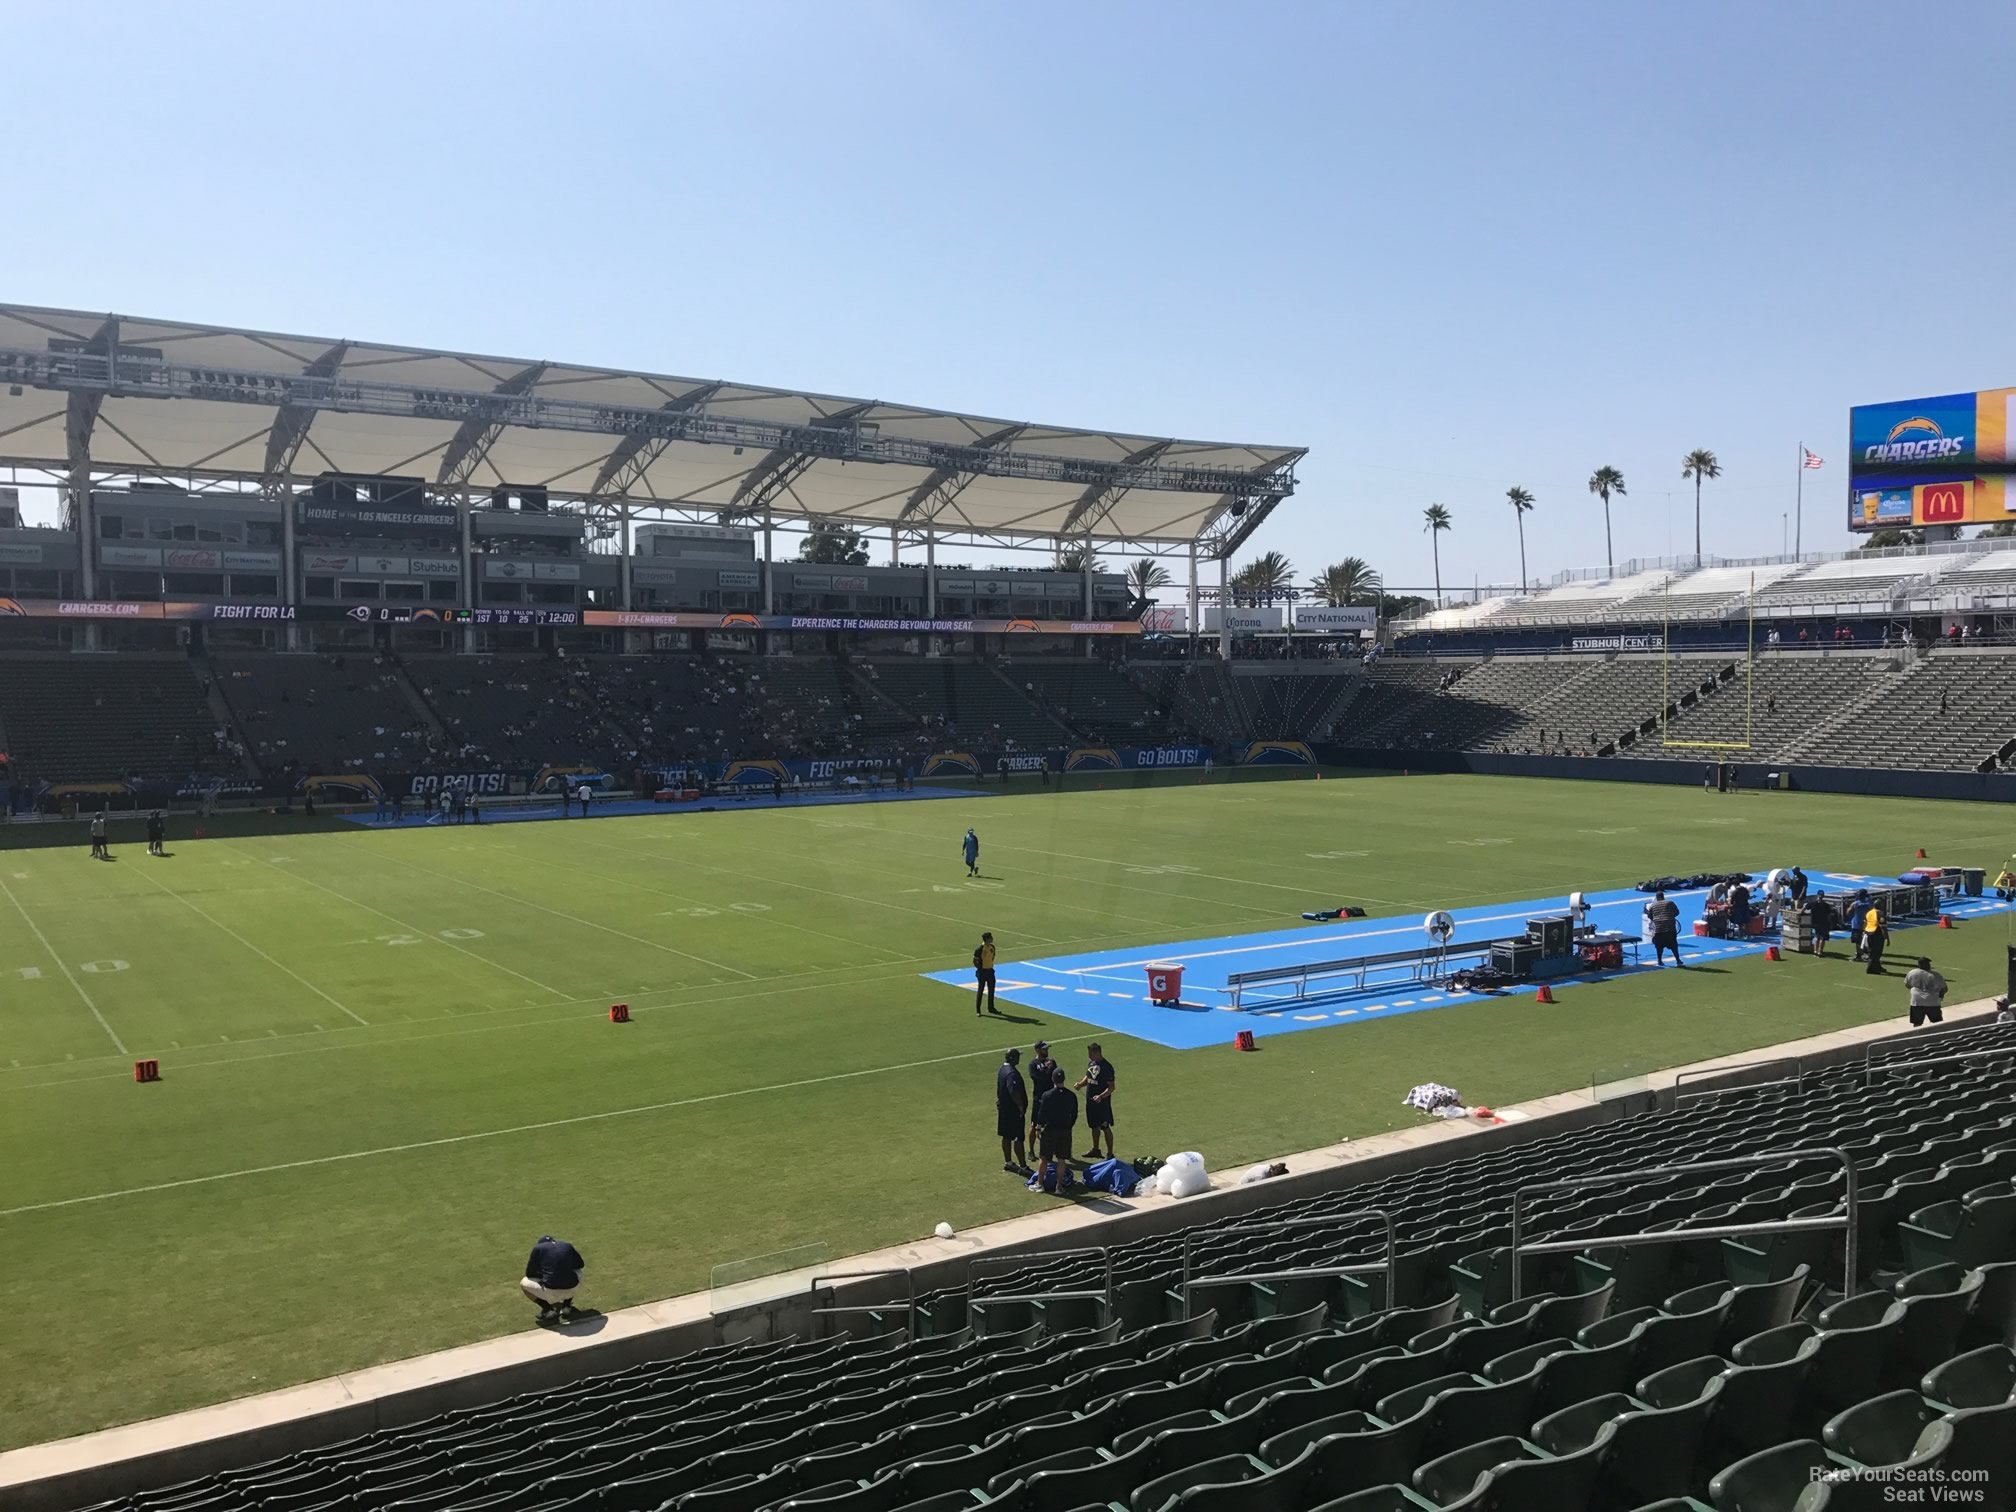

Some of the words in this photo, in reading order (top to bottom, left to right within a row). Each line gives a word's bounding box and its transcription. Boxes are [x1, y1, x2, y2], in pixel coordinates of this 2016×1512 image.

[1865, 436, 1965, 463] CHARGERS
[307, 508, 337, 519] HOME
[358, 511, 374, 521] LOS
[374, 512, 412, 524] ANGELES
[412, 514, 455, 525] CHARGERS
[413, 561, 458, 573] StubHub
[59, 602, 139, 614] CHARGERS.COM
[213, 605, 252, 618] FIGHT
[253, 606, 278, 618] FOR
[280, 607, 295, 619] LA
[381, 608, 388, 620] 0
[444, 610, 452, 621] 0
[477, 615, 490, 623] 1ST
[499, 615, 508, 623] 10
[518, 616, 529, 624] 25
[549, 612, 575, 623] 12:00
[618, 614, 678, 625] 1-877-CHARGERS
[1297, 614, 1318, 624] CITY
[1318, 613, 1367, 623] NATIONAL
[791, 617, 842, 629] EXPERIENCE
[842, 618, 857, 629] THE
[858, 619, 899, 630] CHARGERS
[899, 620, 931, 630] BEYOND
[931, 620, 952, 630] YOUR
[953, 621, 974, 631] SEAT.
[1071, 623, 1114, 632] CHARGERS.COM
[1226, 616, 1262, 628] Corona
[1572, 638, 1620, 648] STUBHUB
[1137, 750, 1154, 765] GO
[1156, 749, 1199, 765] BOLTS!
[411, 775, 438, 794] GO
[1152, 976, 1167, 992] G
[613, 1004, 629, 1022] 20
[1240, 1031, 1253, 1049] 30
[138, 1061, 158, 1081] 10
